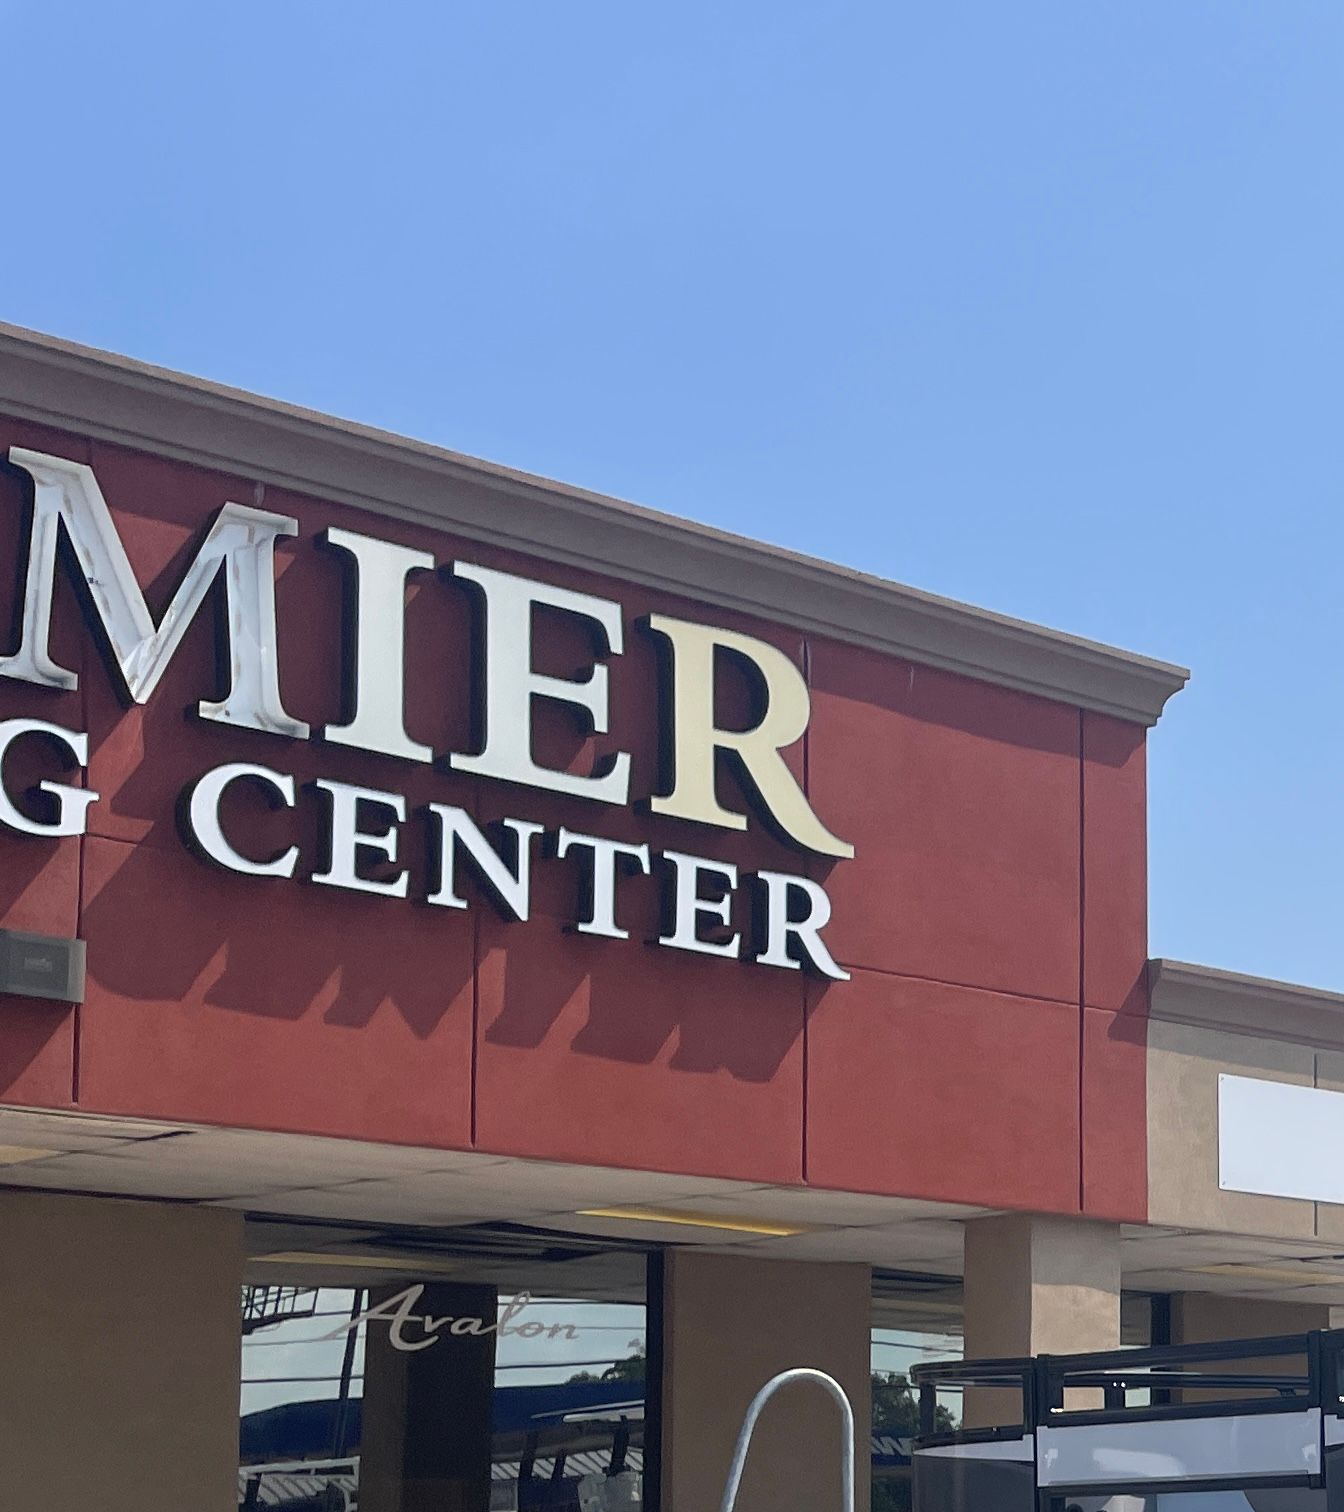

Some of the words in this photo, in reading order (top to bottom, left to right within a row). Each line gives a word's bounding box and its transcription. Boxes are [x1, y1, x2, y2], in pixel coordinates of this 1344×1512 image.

[0, 445, 856, 859] MIER
[190, 762, 851, 981] CENTER
[322, 1284, 580, 1351] Avalon
